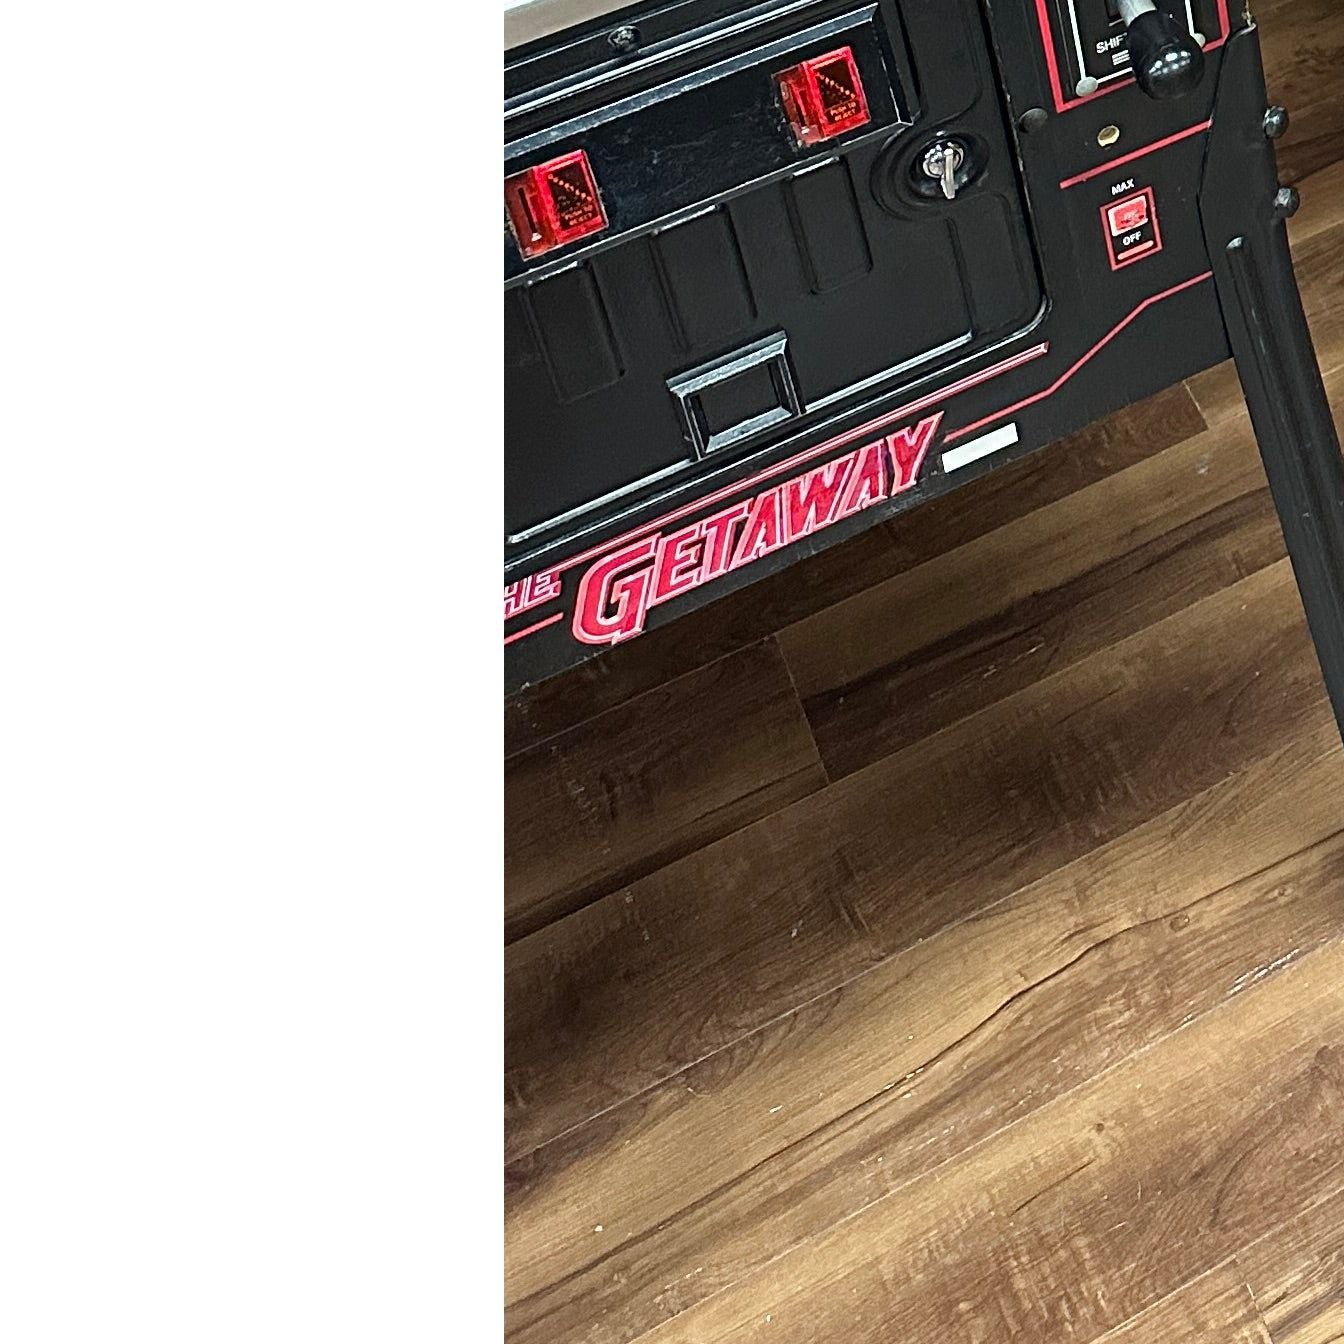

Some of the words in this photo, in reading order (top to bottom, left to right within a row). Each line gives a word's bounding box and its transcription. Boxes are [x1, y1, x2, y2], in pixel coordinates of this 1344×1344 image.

[829, 106, 847, 117] PUSH
[1112, 178, 1135, 195] MAX
[1122, 230, 1142, 247] OFF
[572, 410, 945, 646] GETAWAY
